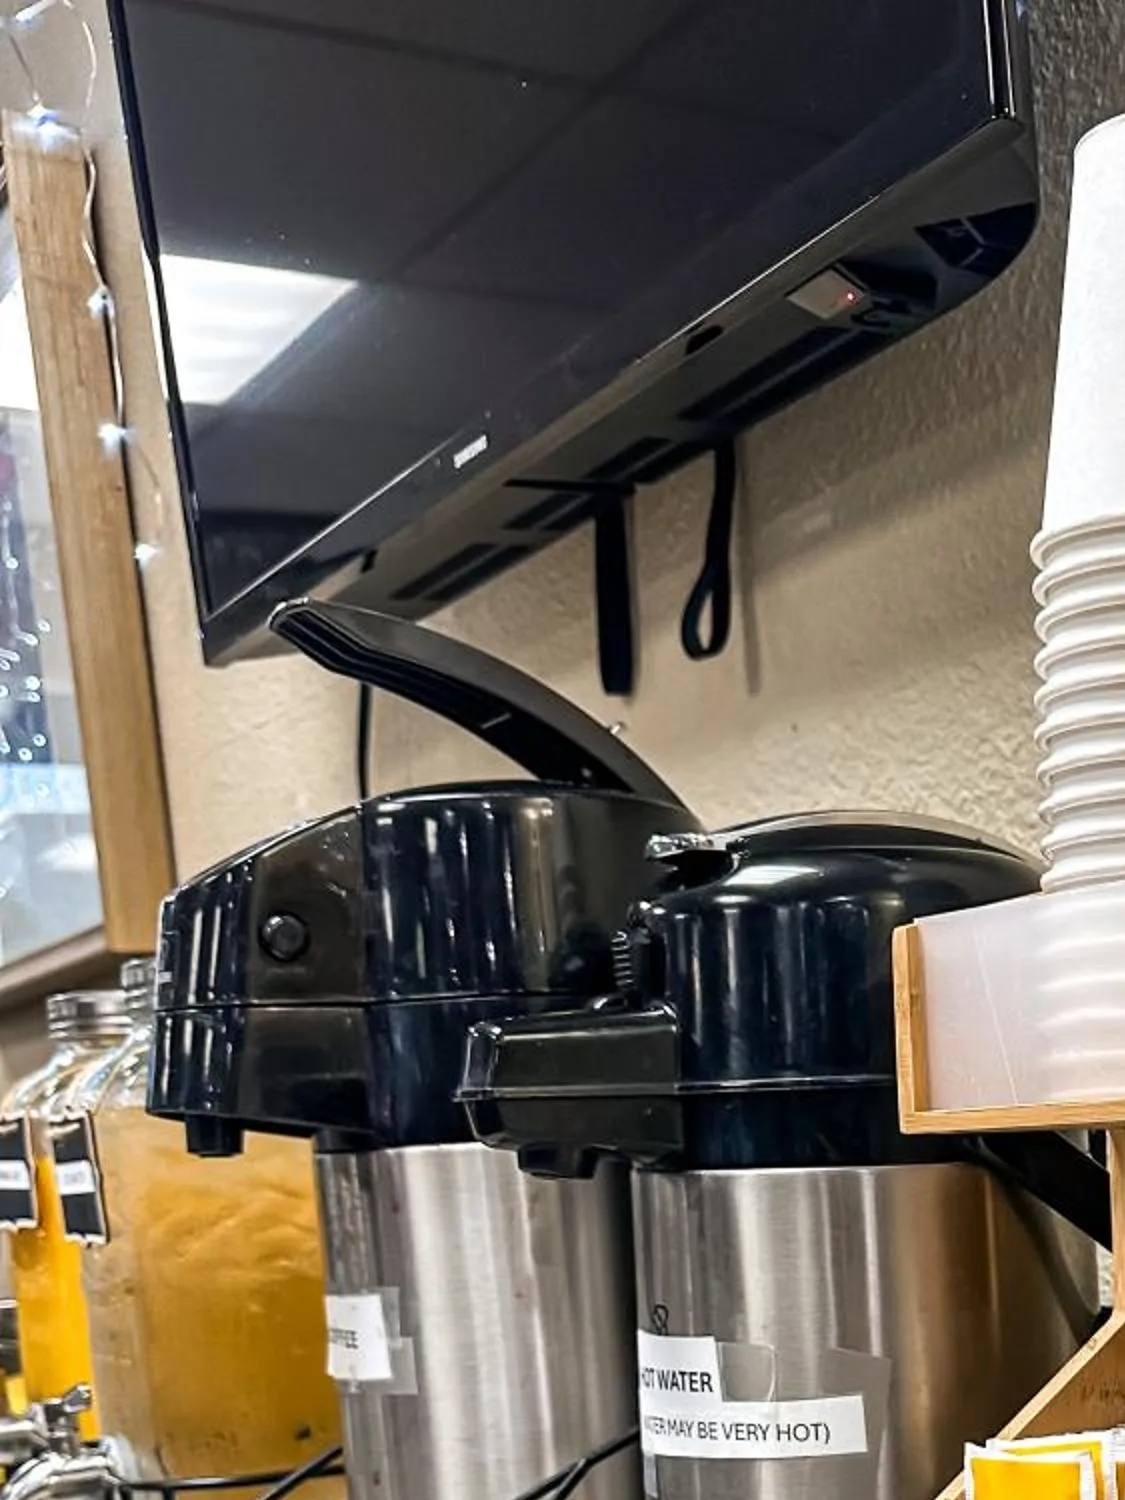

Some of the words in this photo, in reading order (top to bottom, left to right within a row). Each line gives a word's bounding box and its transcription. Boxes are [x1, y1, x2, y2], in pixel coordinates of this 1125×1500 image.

[656, 1370, 714, 1393] WATER
[667, 1419, 694, 1439] MAY
[697, 1421, 718, 1441] BE
[722, 1423, 770, 1442] VERY
[775, 1424, 831, 1444] HOT)
